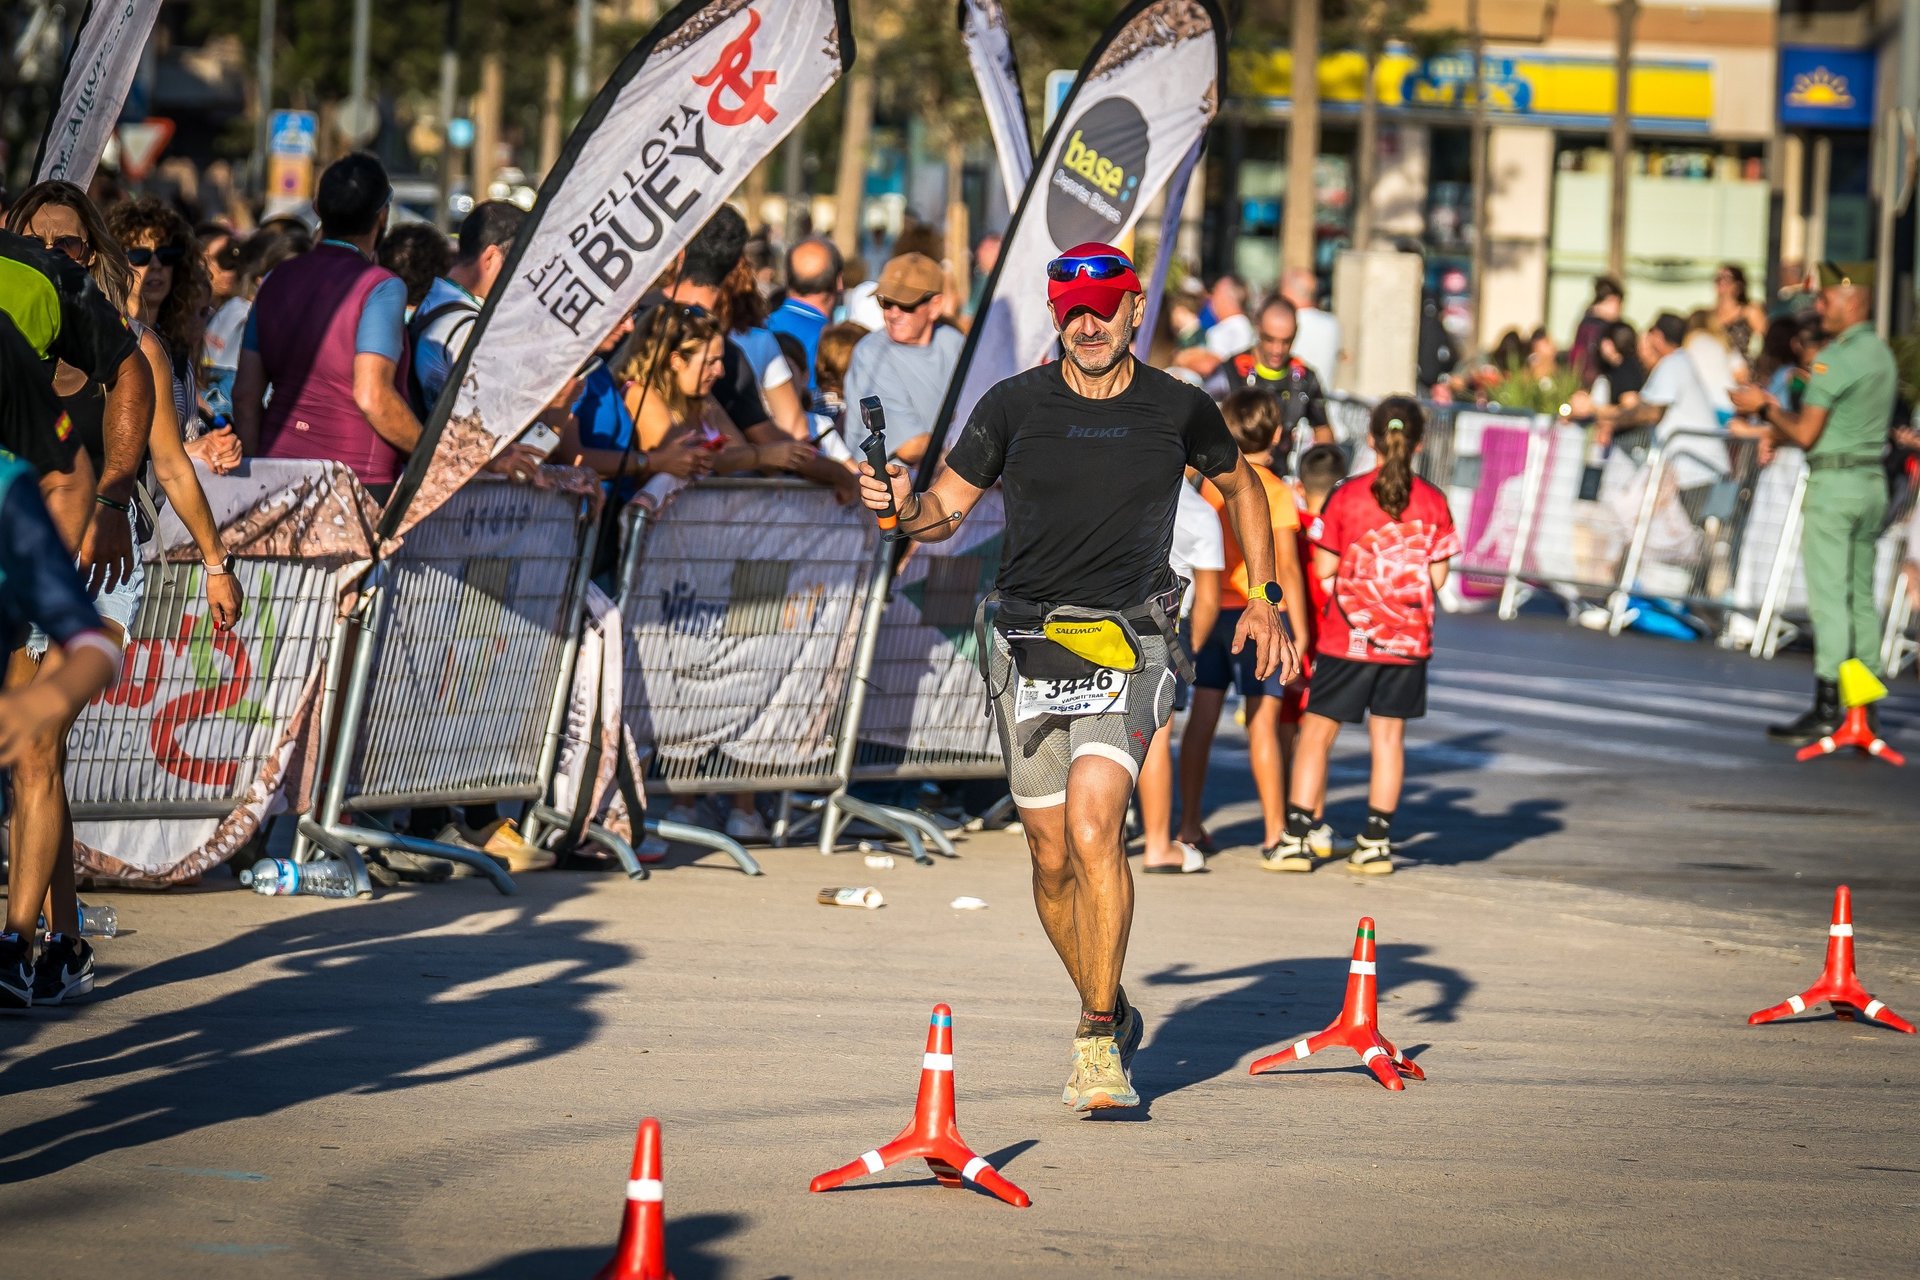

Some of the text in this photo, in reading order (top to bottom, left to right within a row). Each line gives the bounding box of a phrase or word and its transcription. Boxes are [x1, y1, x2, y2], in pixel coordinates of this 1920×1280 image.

[578, 116, 724, 292] BUEY
[1055, 626, 1103, 635] SALOMON
[1045, 669, 1114, 699] 3446
